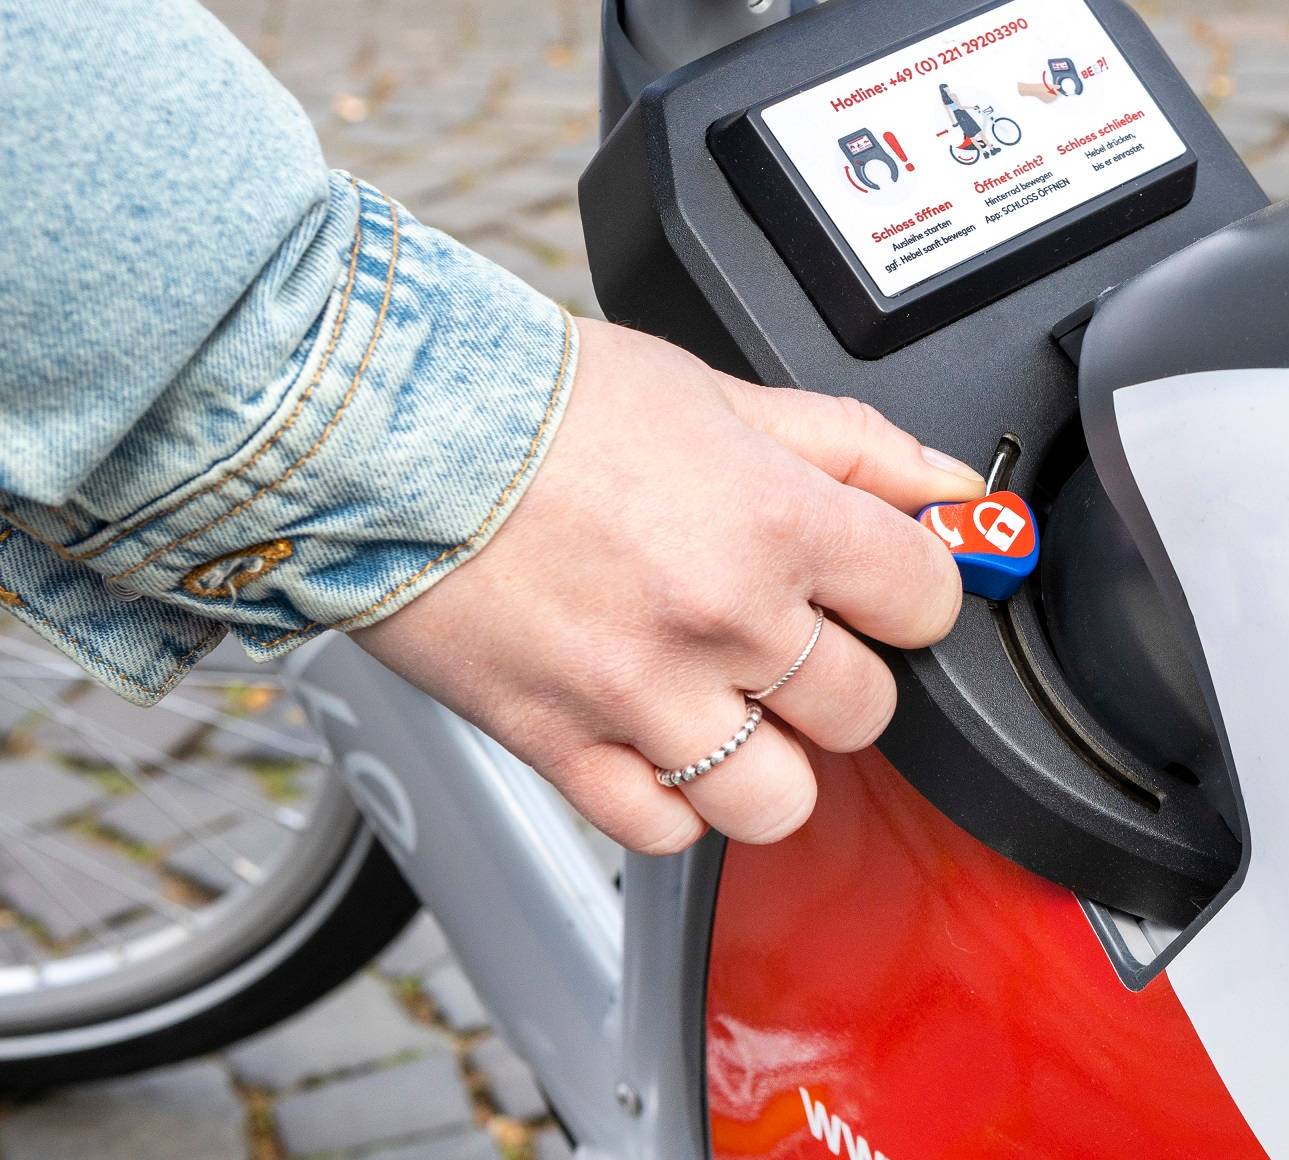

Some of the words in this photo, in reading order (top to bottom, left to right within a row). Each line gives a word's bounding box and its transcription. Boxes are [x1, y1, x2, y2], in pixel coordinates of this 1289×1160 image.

[830, 82, 888, 112] Hotline:
[889, 68, 913, 86] +49
[915, 57, 938, 76] (0)
[938, 47, 963, 65] 221
[961, 17, 1029, 54] 29203390
[1057, 132, 1098, 155] Schloss
[1098, 110, 1145, 137] schließen
[1084, 144, 1107, 159] Hebel
[1106, 132, 1136, 150] drücken,
[973, 171, 1013, 194] Öffnet
[1012, 155, 1044, 177] nicht?
[1092, 162, 1105, 172] bis
[1104, 158, 1113, 166] er
[1113, 143, 1145, 162] einrastet
[984, 185, 1021, 207] Hinterrad
[1019, 171, 1054, 191] bewegen
[985, 211, 1003, 224] App:
[1001, 192, 1039, 216] SCHLOSS
[1037, 177, 1071, 198] ÖFFNEN
[871, 218, 915, 243] Schloss
[914, 200, 953, 223] öffnen
[892, 232, 924, 252] Ausleihe
[923, 219, 952, 237] starten
[885, 259, 902, 274] ggf.
[899, 247, 924, 264] Hebel
[922, 239, 943, 254] sanft
[941, 223, 977, 245] bewegen
